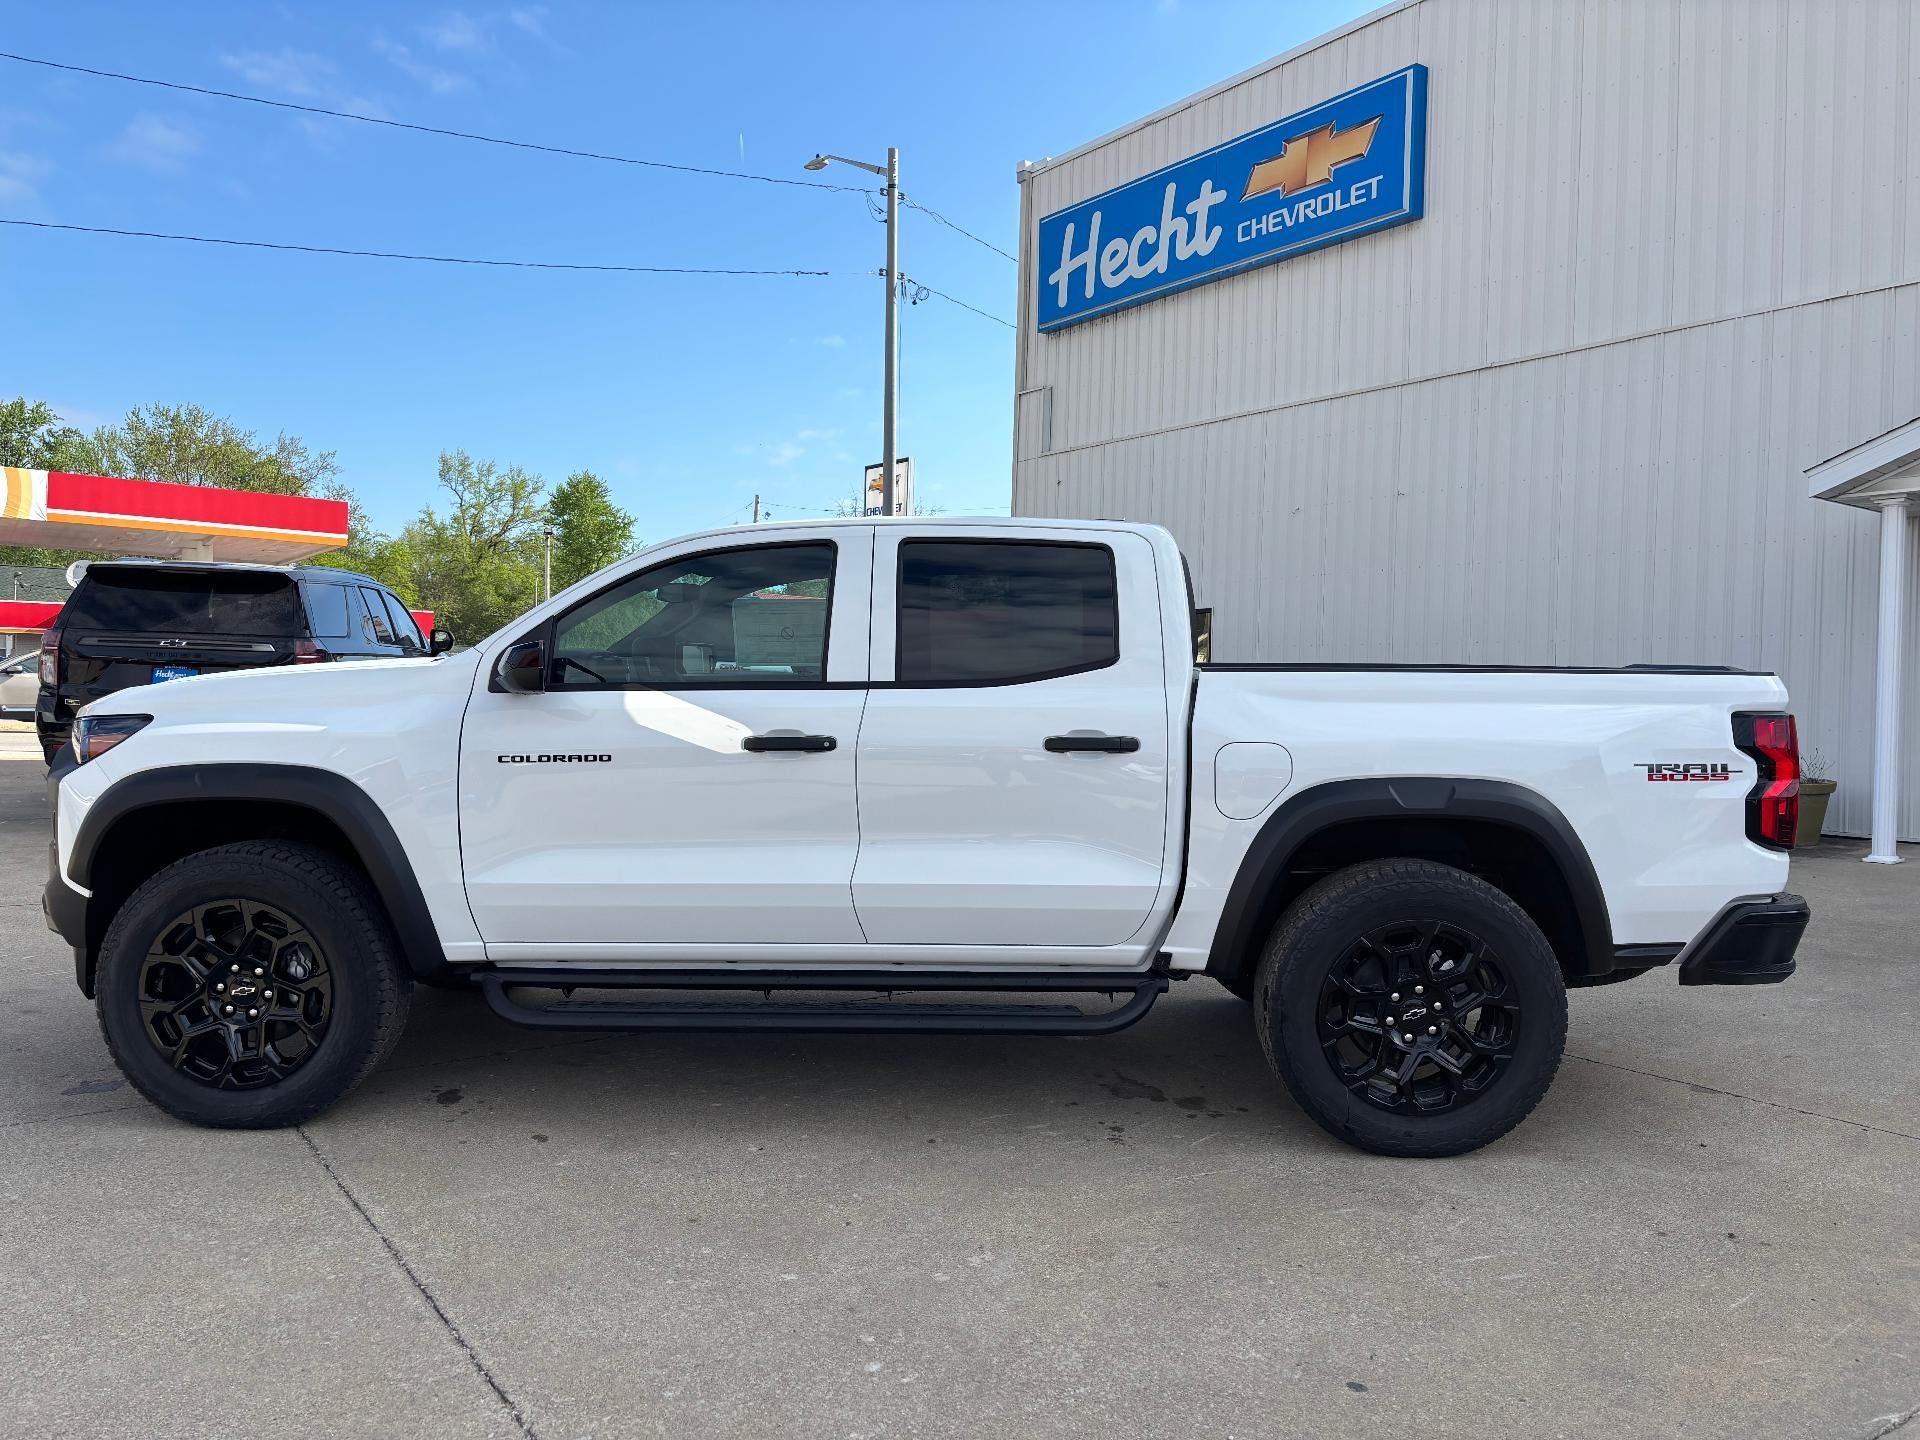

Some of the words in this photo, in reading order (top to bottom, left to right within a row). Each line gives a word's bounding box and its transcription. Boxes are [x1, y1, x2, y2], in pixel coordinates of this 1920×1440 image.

[1237, 174, 1384, 243] CHEVROLET
[1048, 179, 1227, 308] Hecht
[497, 754, 612, 763] COLORADO
[1633, 763, 1743, 774] TRAIL
[1647, 773, 1729, 781] BOSS
